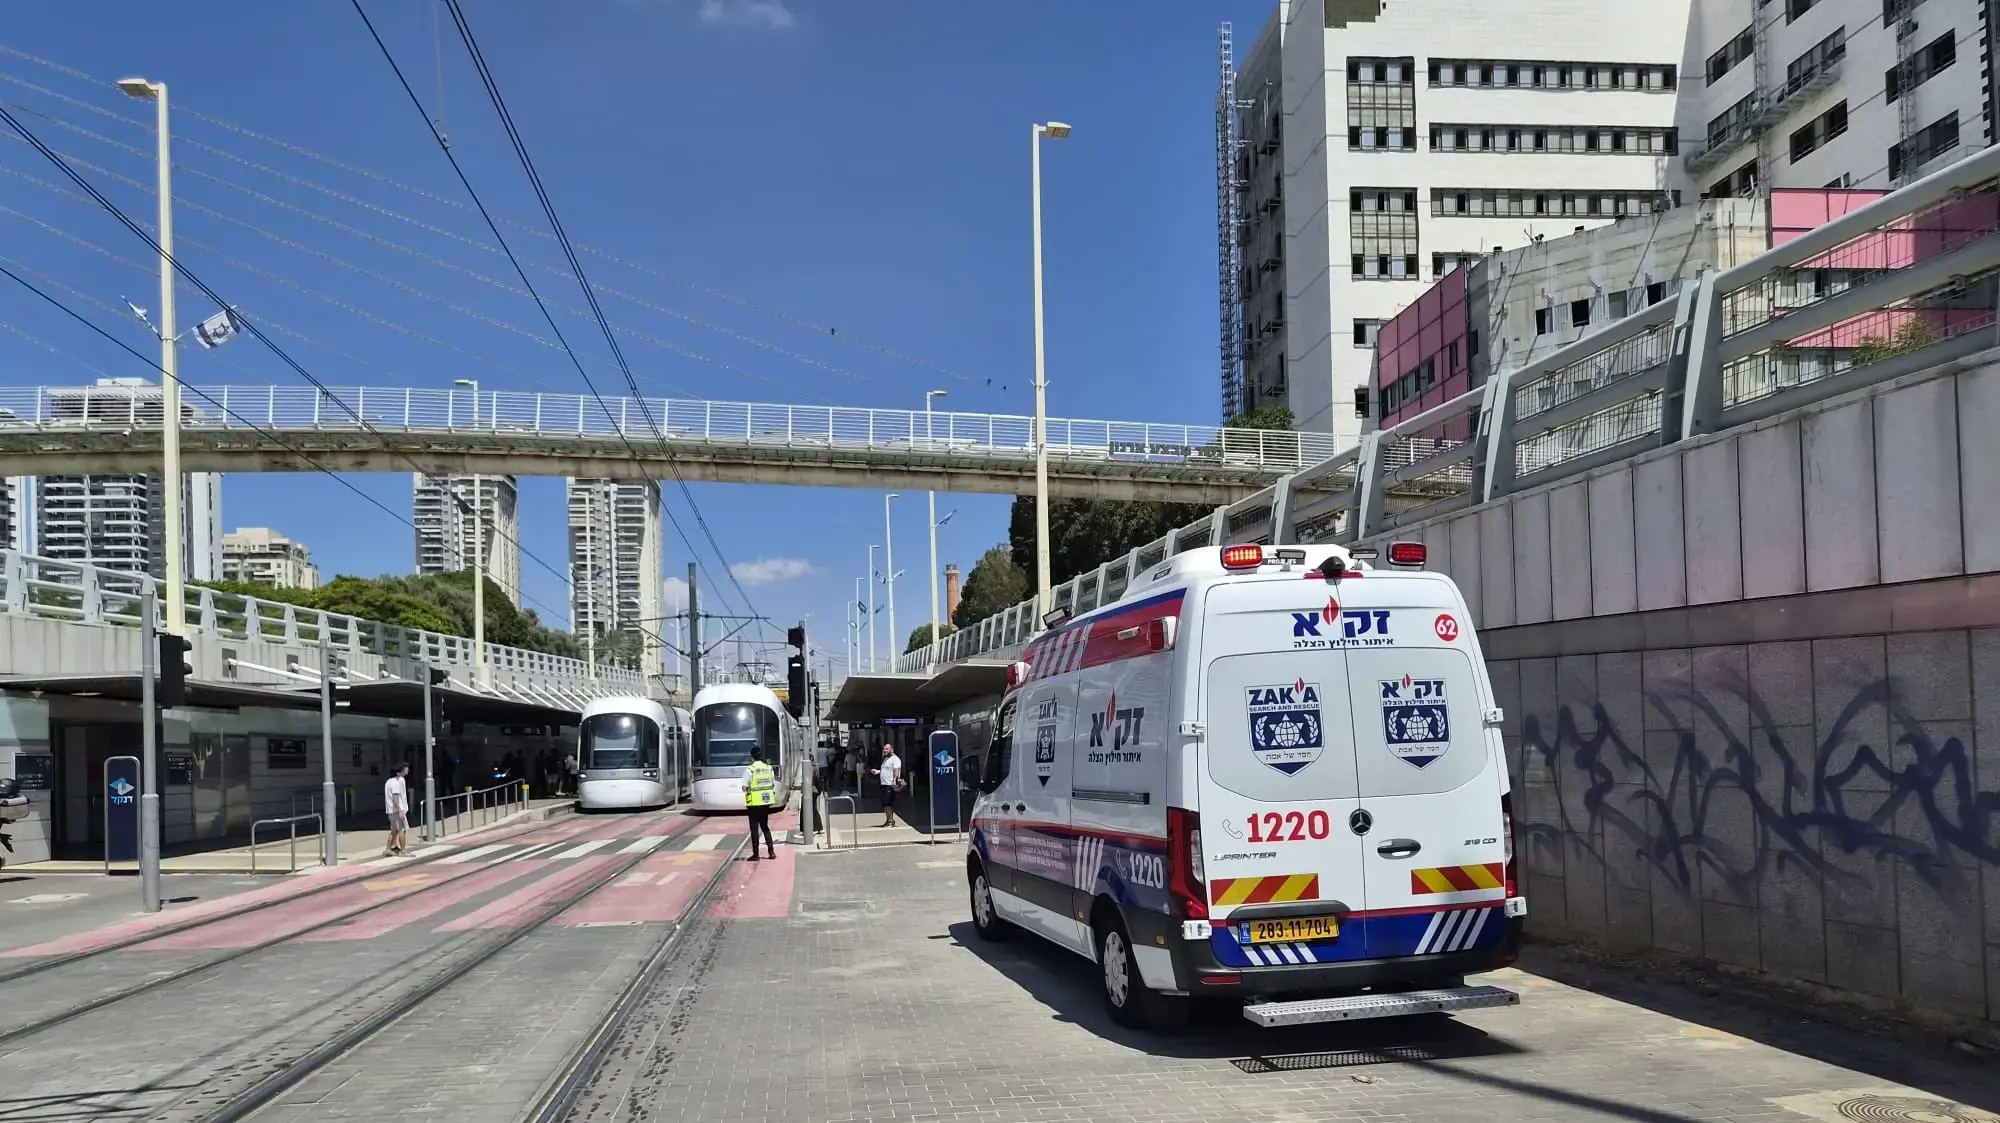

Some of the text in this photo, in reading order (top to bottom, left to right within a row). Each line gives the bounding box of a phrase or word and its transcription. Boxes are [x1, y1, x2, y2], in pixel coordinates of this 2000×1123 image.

[1436, 619, 1457, 636] 62
[1293, 638, 1394, 649] איתור חילוץ הצלה
[1088, 750, 1142, 766] איתור חילוץ הצלה
[1283, 750, 1295, 759] של
[936, 766, 955, 775] דנקל
[111, 795, 133, 807] דנקל
[1246, 809, 1330, 843] 1220
[1129, 852, 1164, 889] 1220
